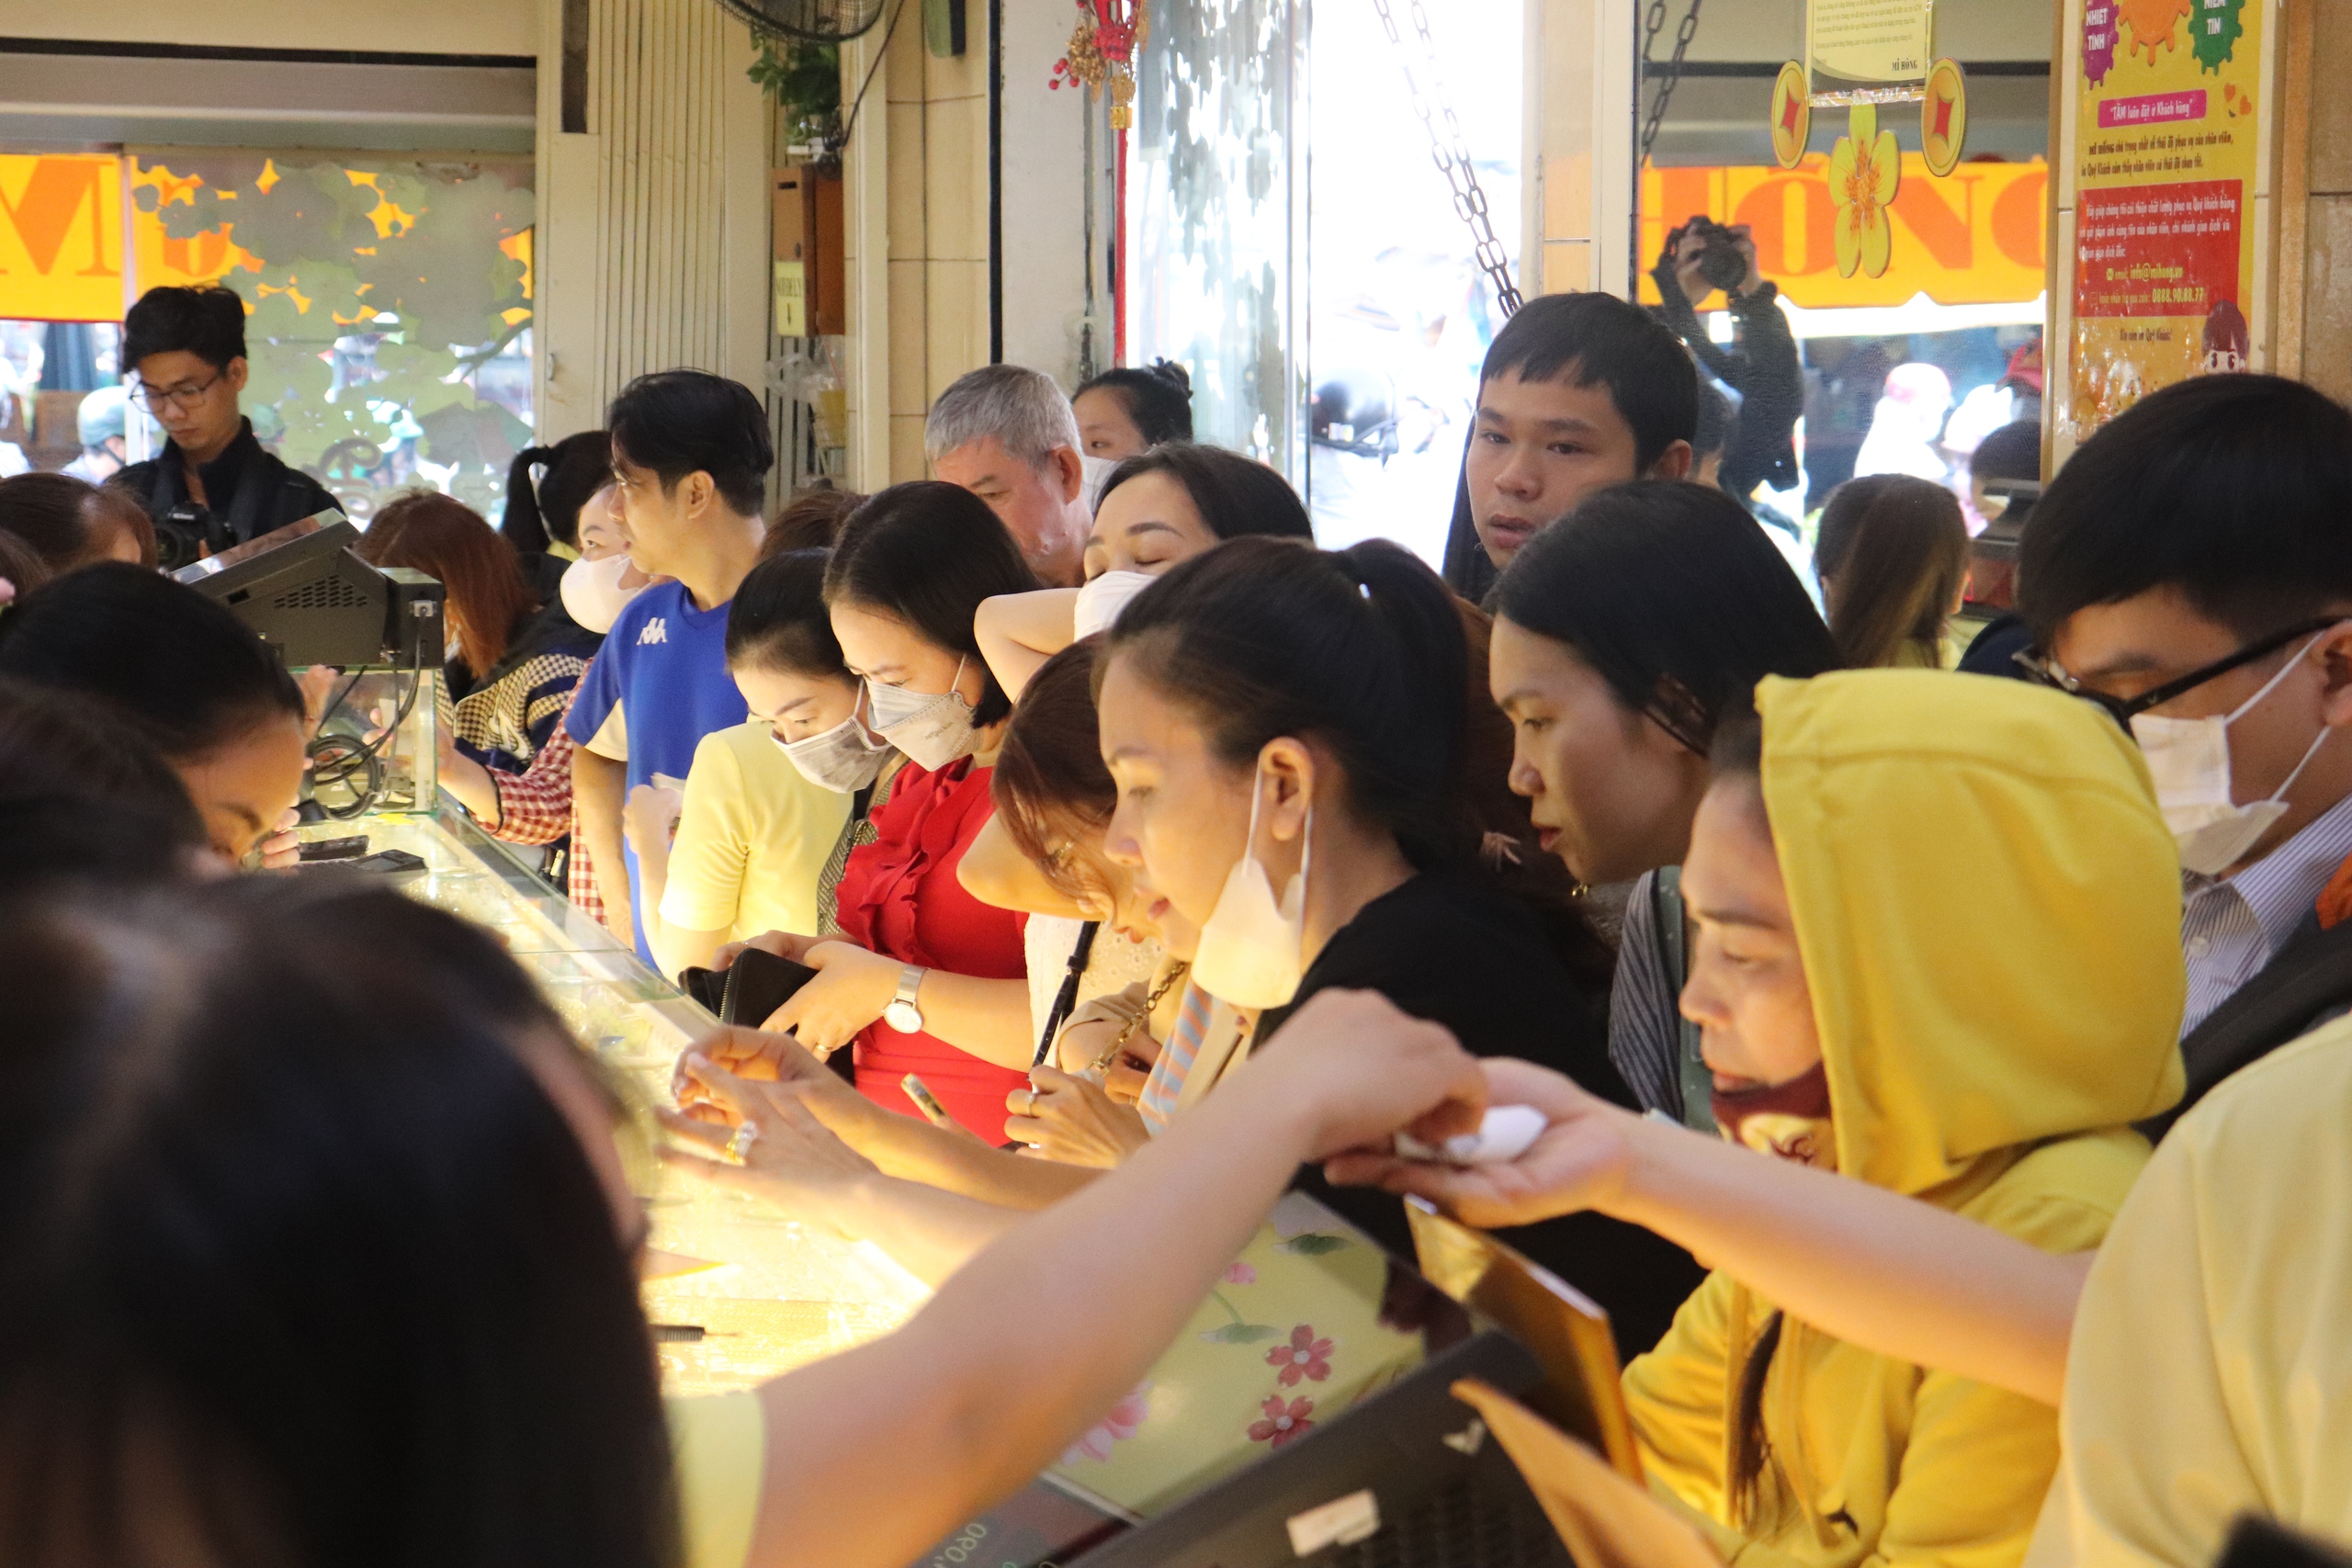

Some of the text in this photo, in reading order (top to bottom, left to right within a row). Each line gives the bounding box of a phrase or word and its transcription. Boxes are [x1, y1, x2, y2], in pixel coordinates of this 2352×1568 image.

[2207, 17, 2221, 35] TIN
[2157, 101, 2174, 117] Khách
[2152, 287, 2204, 304] 0888.90.88.77
